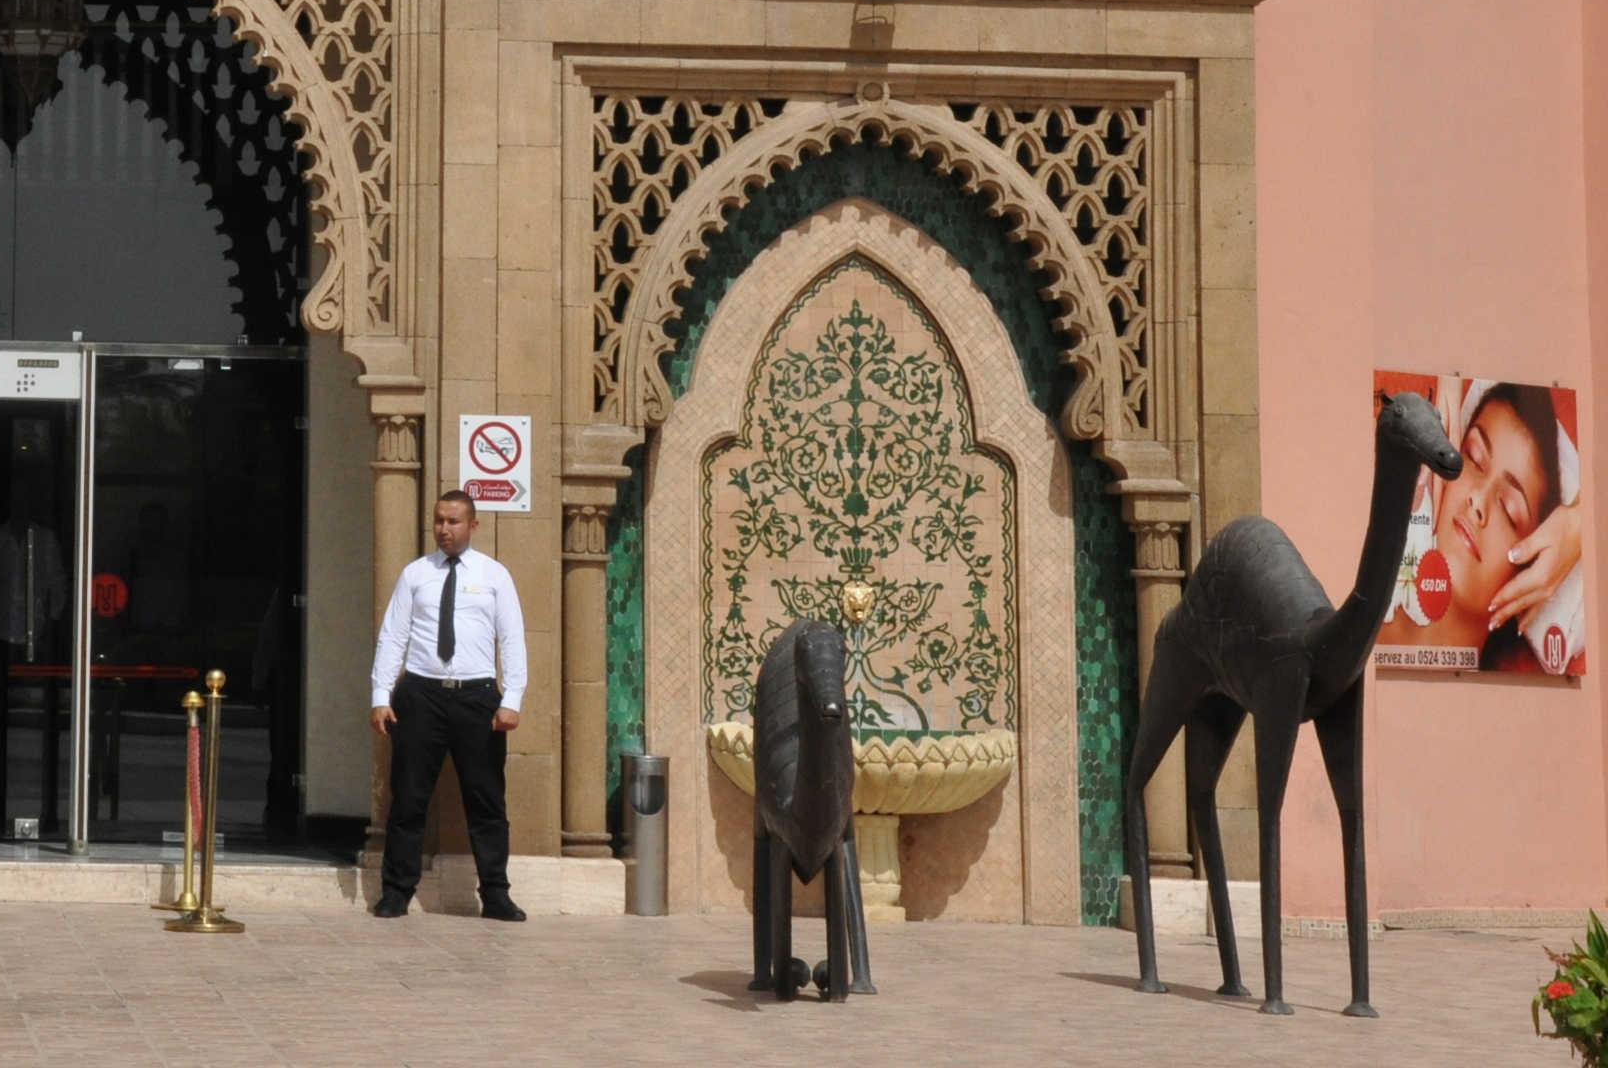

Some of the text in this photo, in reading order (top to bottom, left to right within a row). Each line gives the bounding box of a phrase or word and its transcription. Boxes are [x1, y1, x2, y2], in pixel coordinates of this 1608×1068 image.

[483, 490, 511, 498] PARKING
[1420, 578, 1448, 592] 450 DH
[1404, 653, 1416, 664] au
[1418, 650, 1439, 665] 0524
[1441, 651, 1457, 666] 339
[1459, 651, 1476, 666] 398
